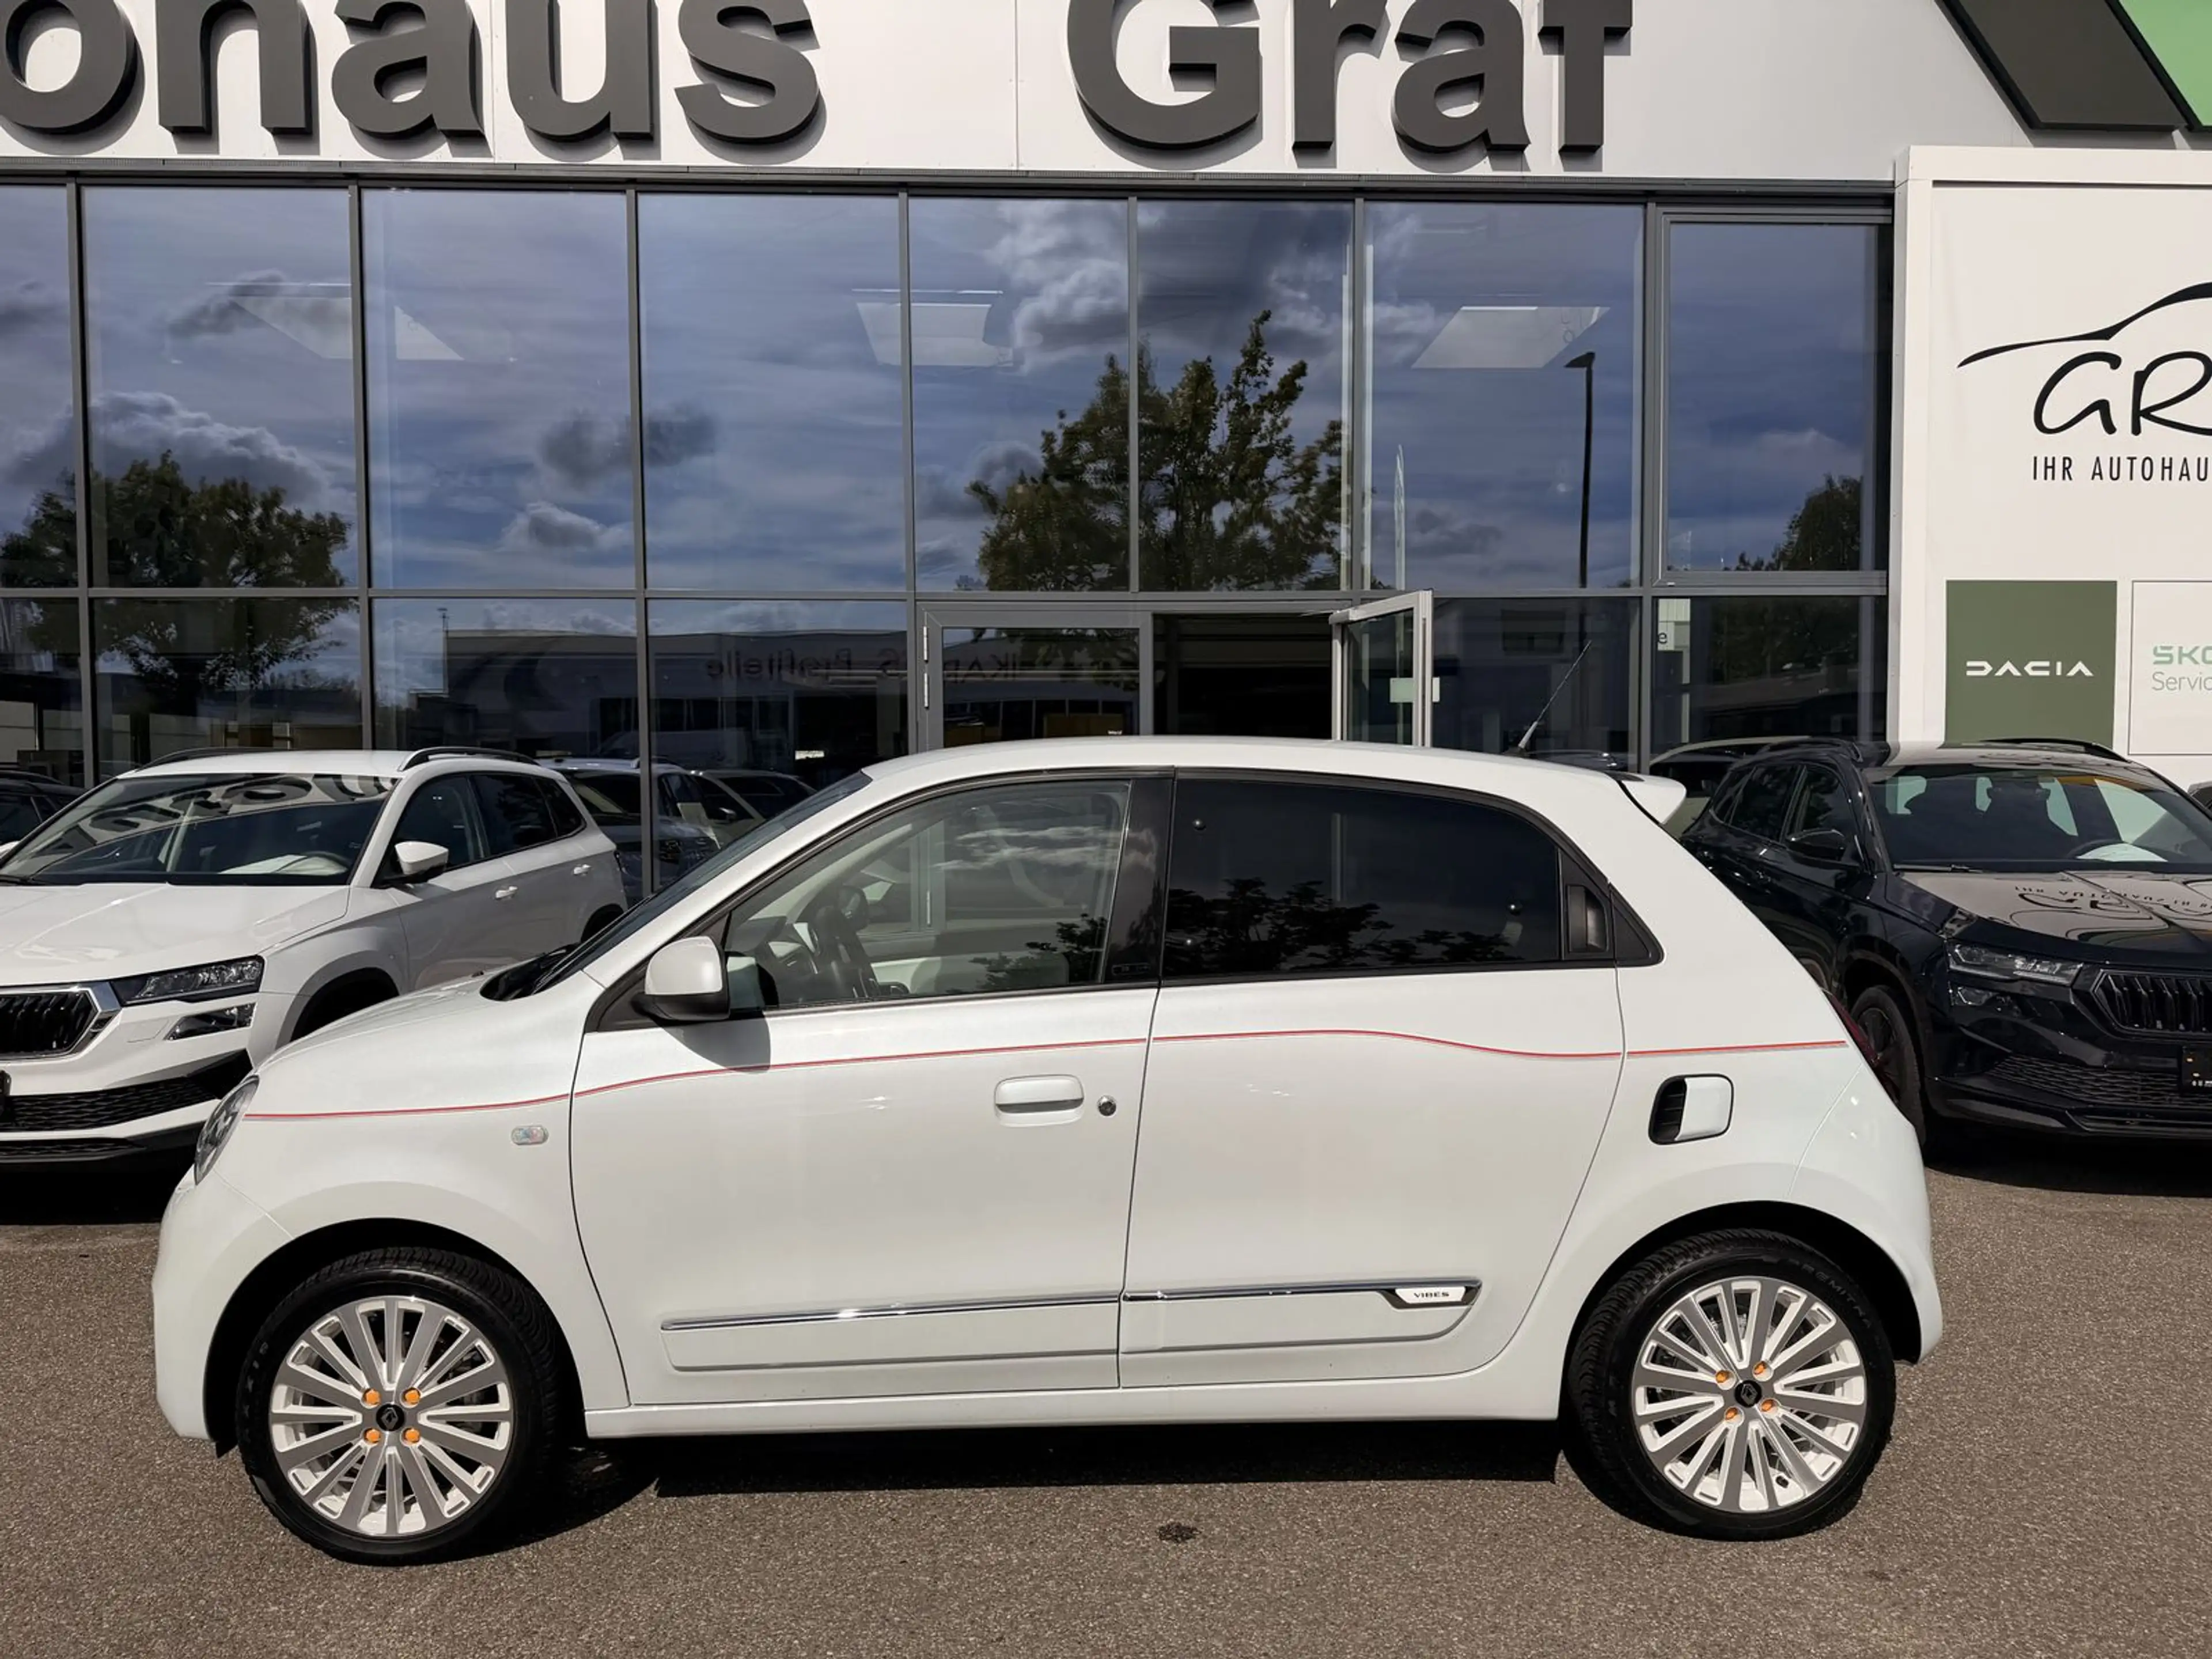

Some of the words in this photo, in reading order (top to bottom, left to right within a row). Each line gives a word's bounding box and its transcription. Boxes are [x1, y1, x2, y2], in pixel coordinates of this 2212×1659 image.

[2032, 456, 2073, 482] IHR
[2090, 456, 2209, 482] AUTOHAU
[1966, 660, 2094, 677] DACIA
